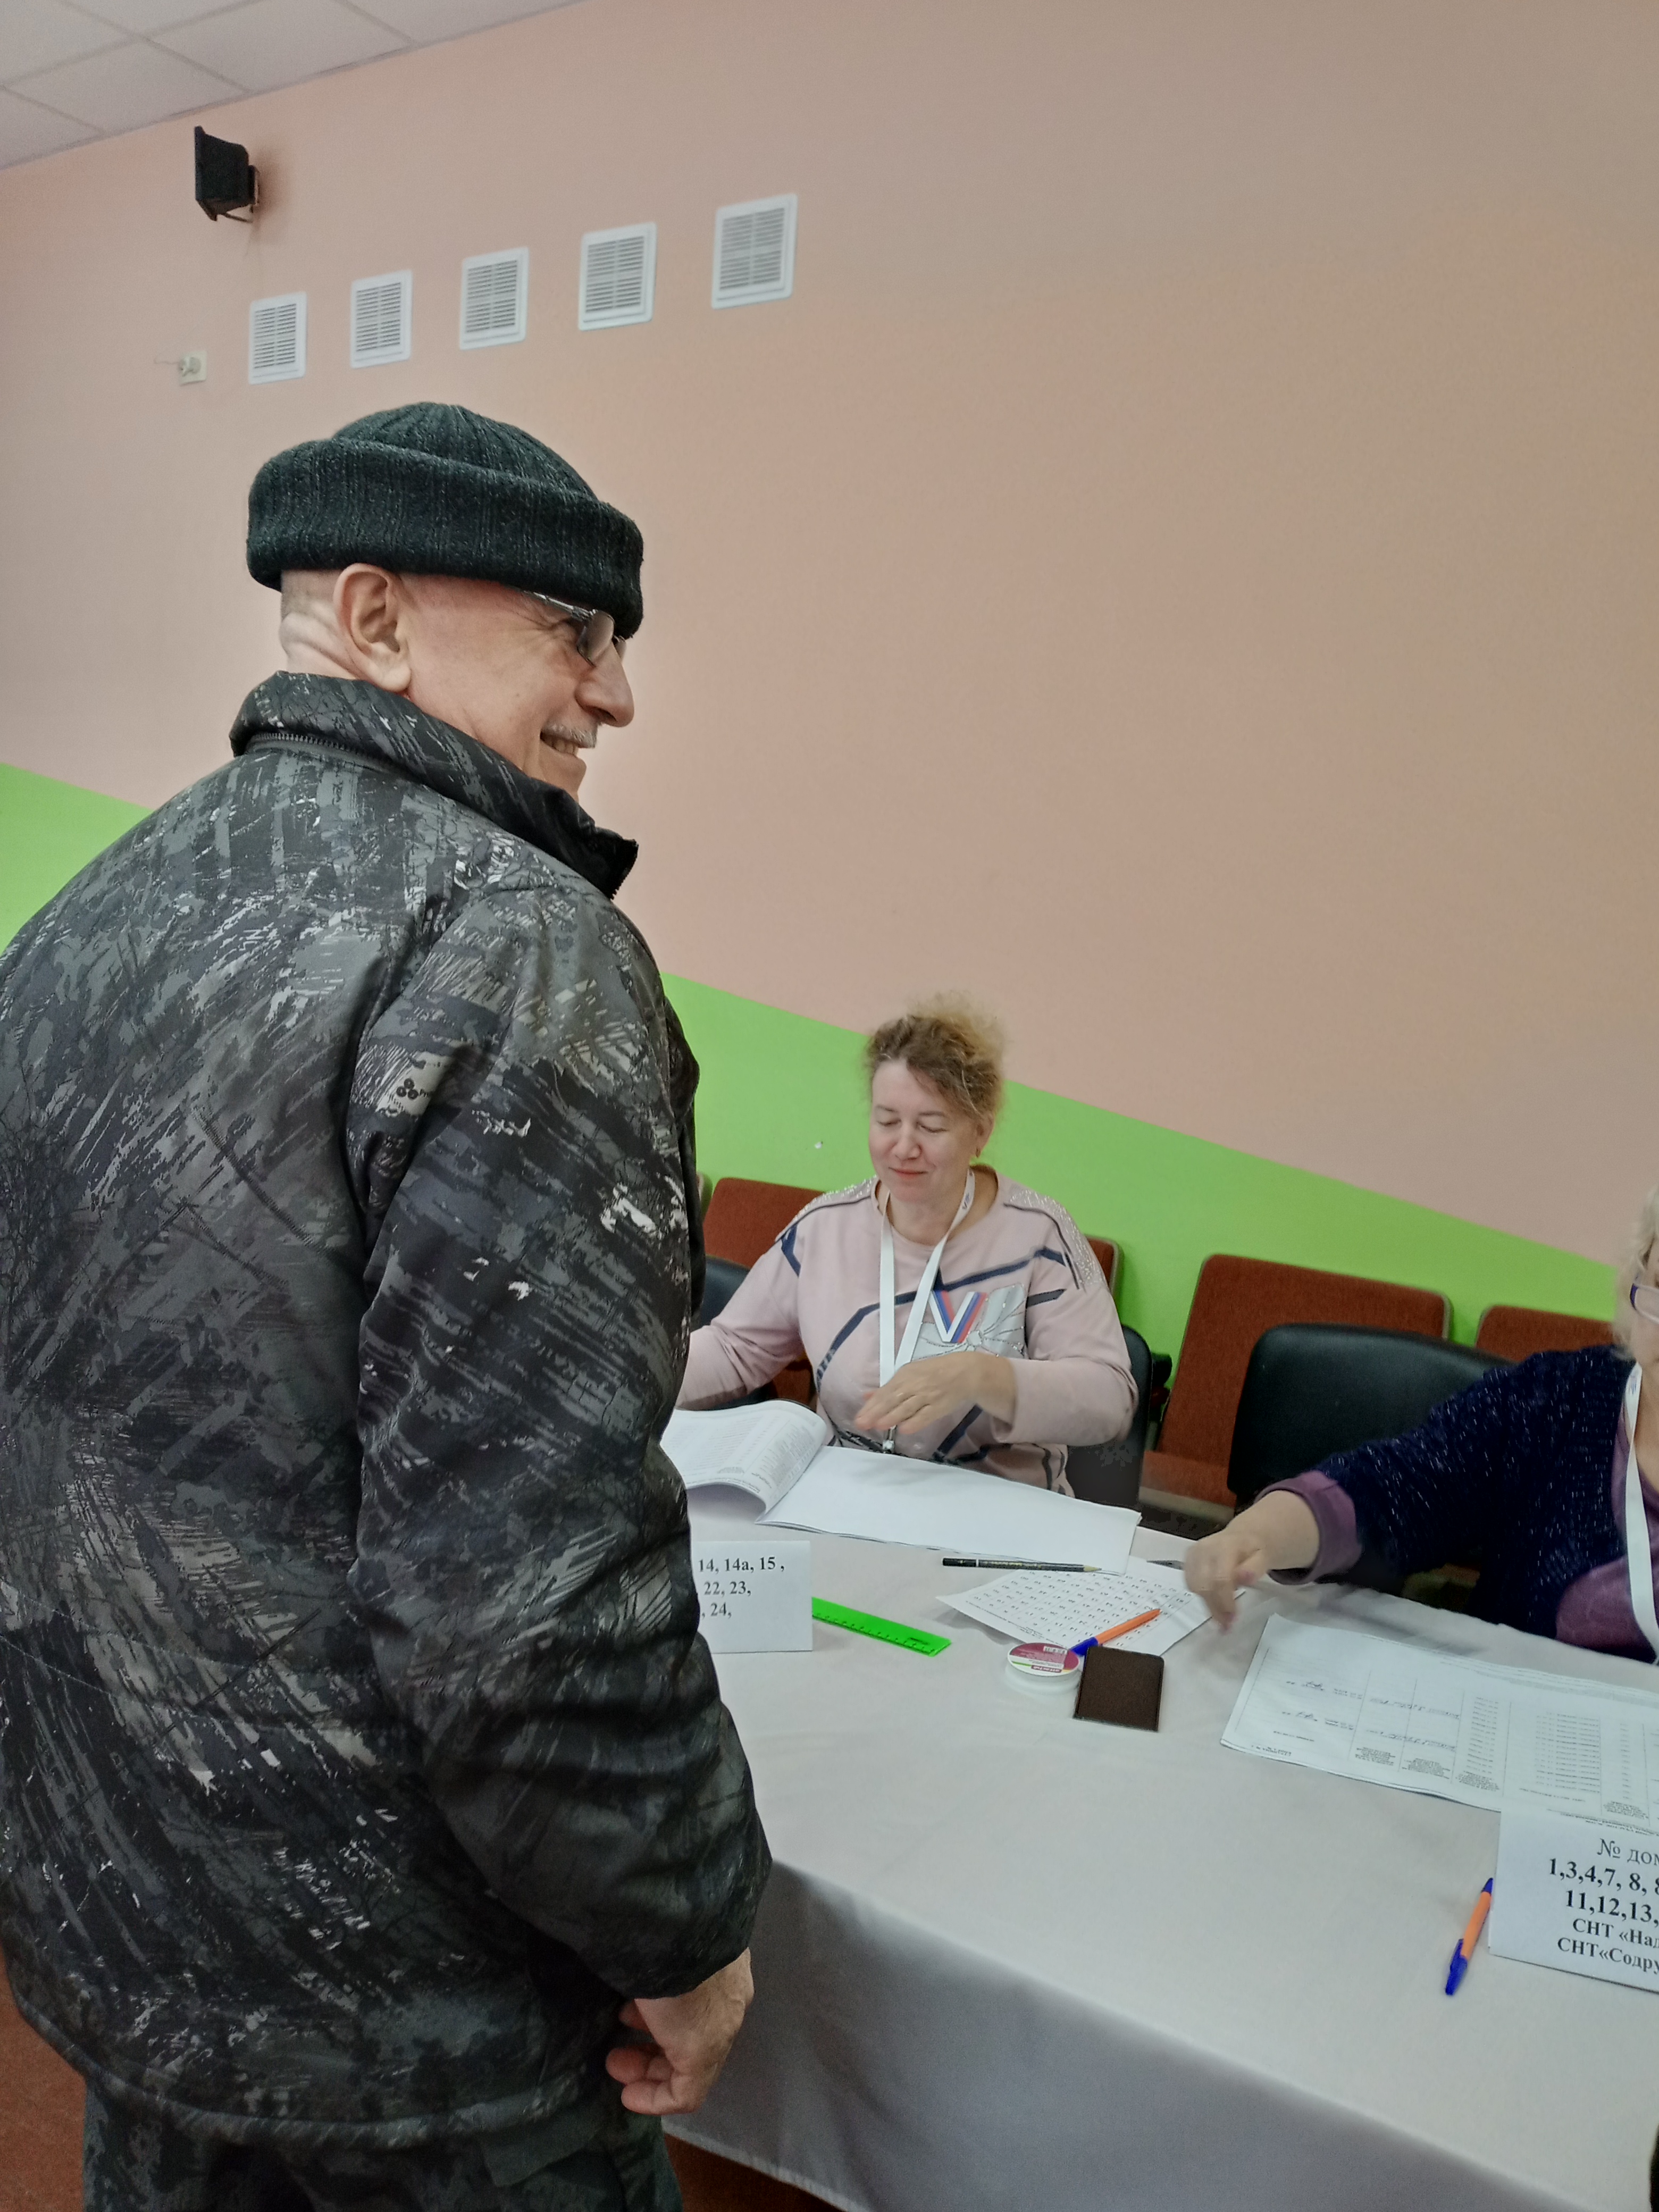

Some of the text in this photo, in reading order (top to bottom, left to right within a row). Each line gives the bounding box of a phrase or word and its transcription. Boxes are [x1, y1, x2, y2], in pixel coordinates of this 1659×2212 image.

[699, 1559, 718, 1573] 14,
[704, 1581, 751, 1597] 22, 23,
[710, 1602, 732, 1619] 24,
[1597, 1838, 1621, 1859] №
[1549, 1858, 1621, 1891] 1,3,4,7,
[1629, 1873, 1647, 1896] 8,
[1566, 1890, 1658, 1928] 11,12,13,
[1573, 1918, 1614, 1938] СНТ
